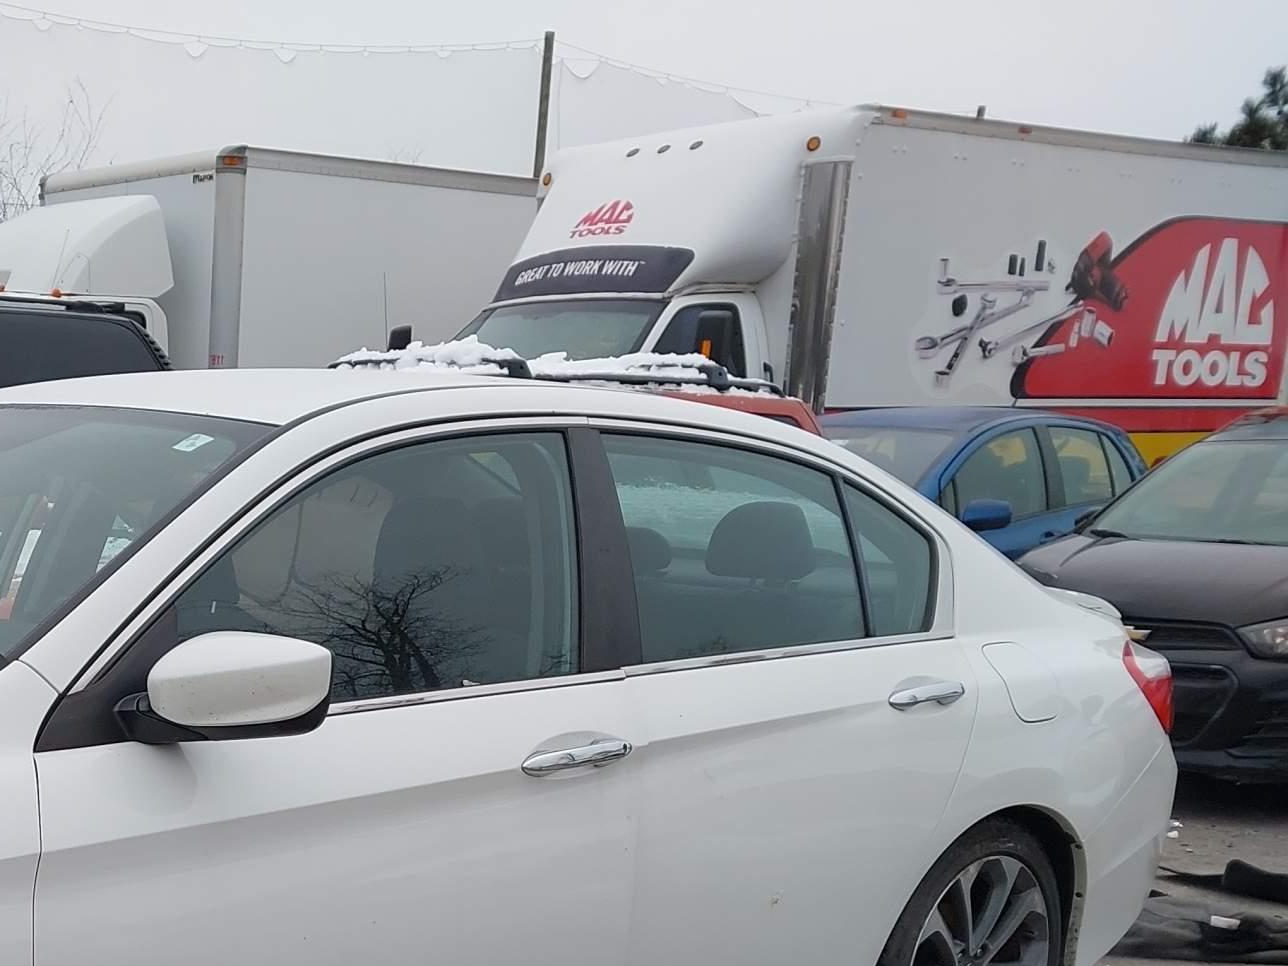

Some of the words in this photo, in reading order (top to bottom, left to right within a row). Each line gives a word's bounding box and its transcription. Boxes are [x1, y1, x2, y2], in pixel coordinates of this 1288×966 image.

[575, 200, 634, 228] MAC
[569, 225, 627, 239] TOOLS
[515, 265, 546, 286] GREAT
[546, 263, 564, 278] TO
[564, 261, 600, 276] WORK
[601, 260, 639, 276] WITH
[1154, 237, 1275, 345] MAC
[1152, 349, 1269, 387] TOOLS
